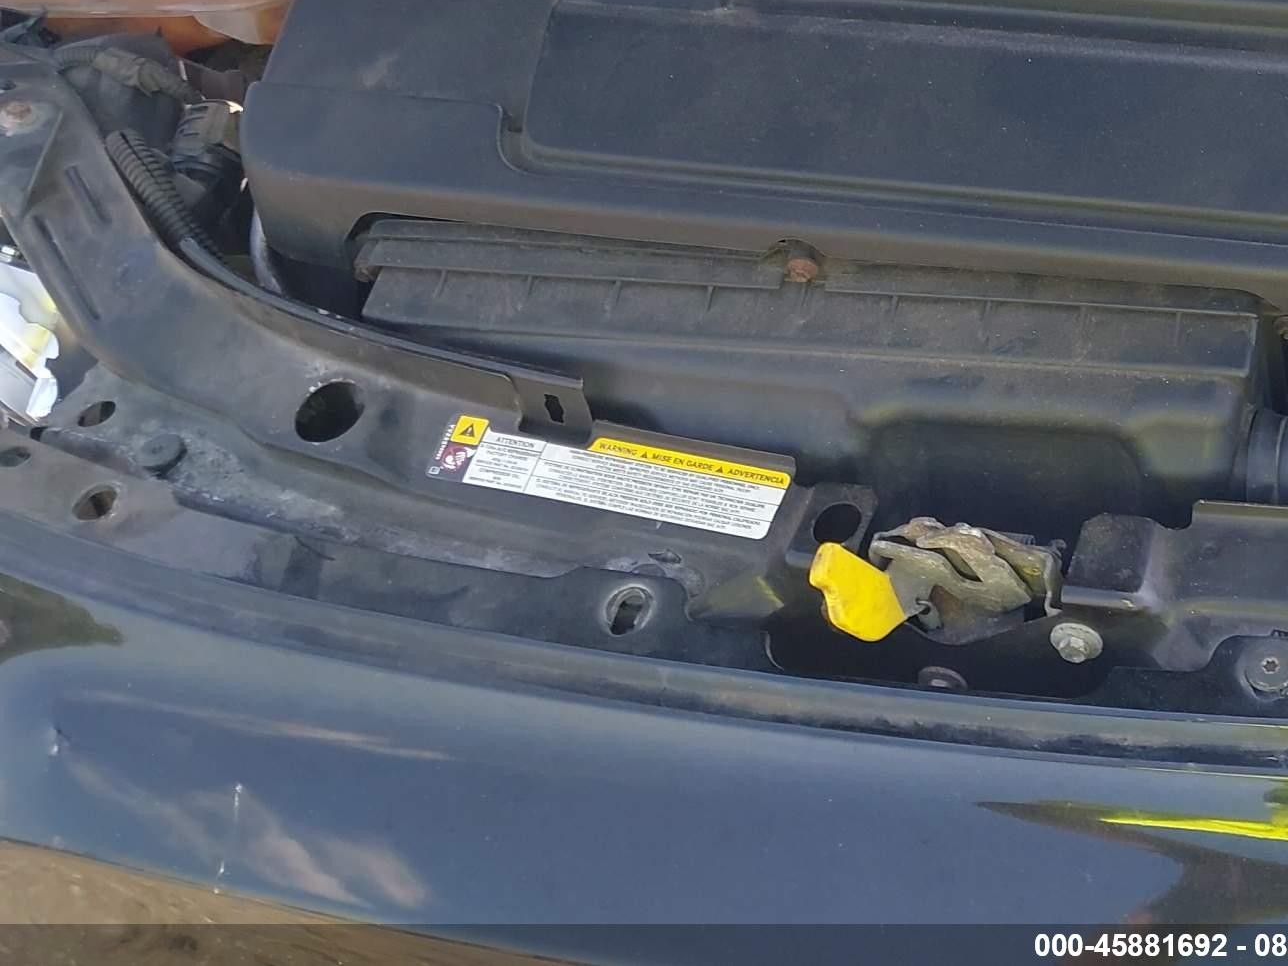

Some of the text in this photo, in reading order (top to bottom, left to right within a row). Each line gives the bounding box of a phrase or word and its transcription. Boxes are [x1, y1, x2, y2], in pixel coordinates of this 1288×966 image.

[495, 435, 536, 450] ATTENTION
[598, 441, 786, 485] WARNING MISE EN GARDE ADVERTENCIA
